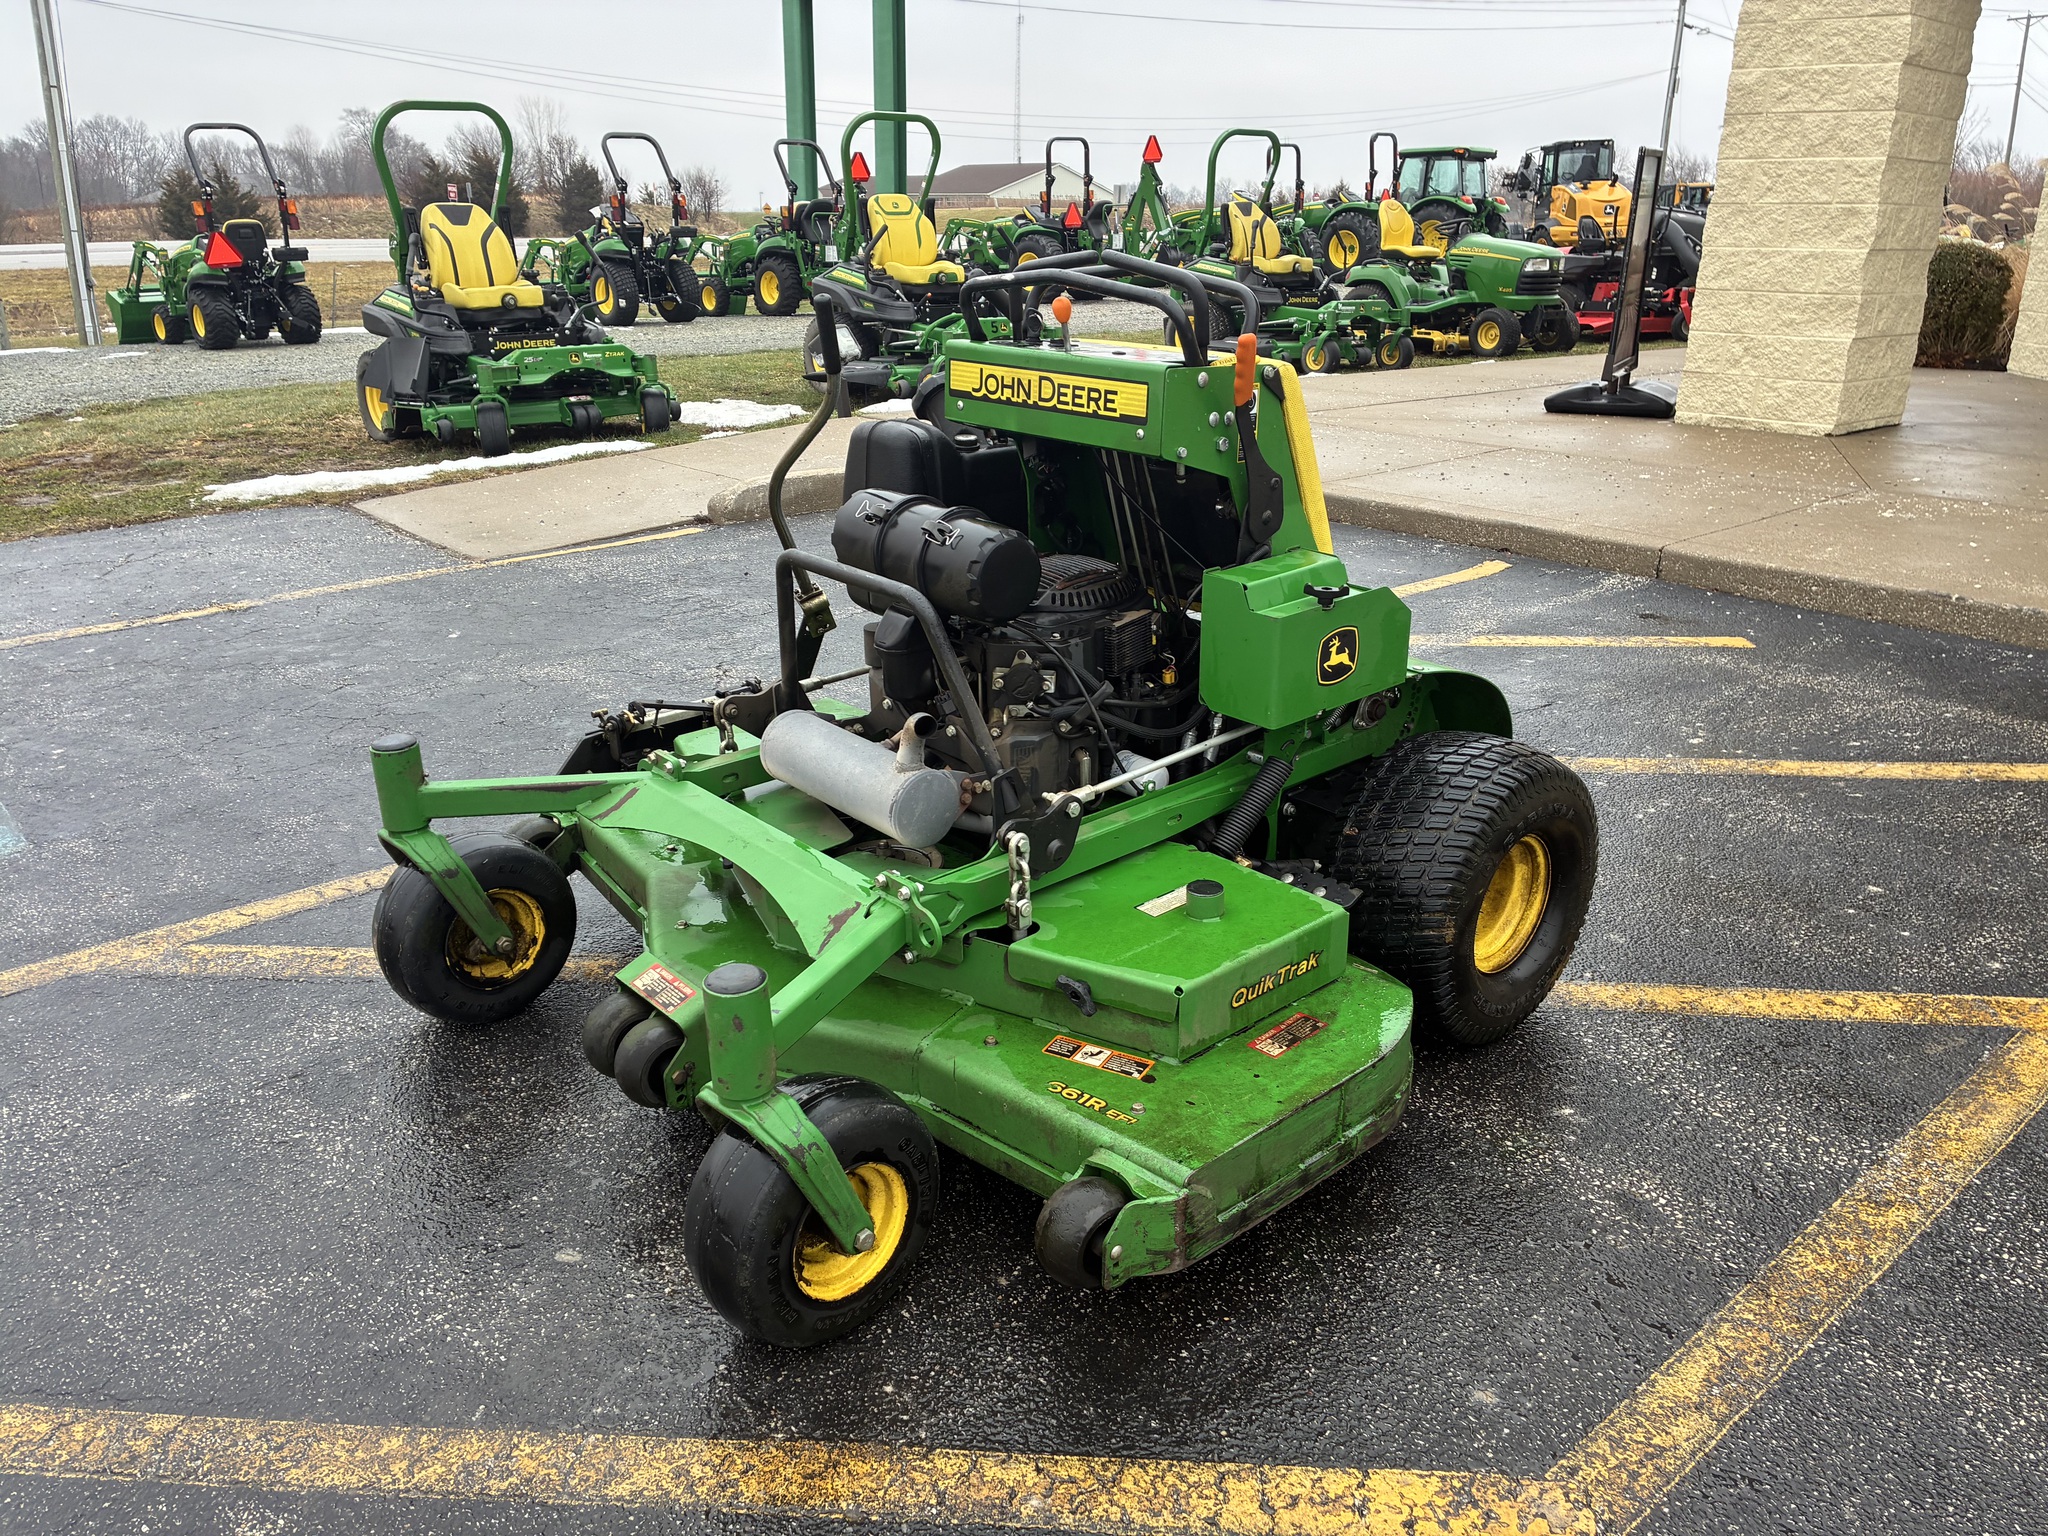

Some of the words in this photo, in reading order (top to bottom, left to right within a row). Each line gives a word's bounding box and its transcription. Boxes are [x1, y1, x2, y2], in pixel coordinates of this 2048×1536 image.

[494, 341, 521, 350] JOHN
[522, 339, 556, 348] DEERE
[971, 367, 1032, 402] JOHN
[1037, 375, 1119, 413] DEERE
